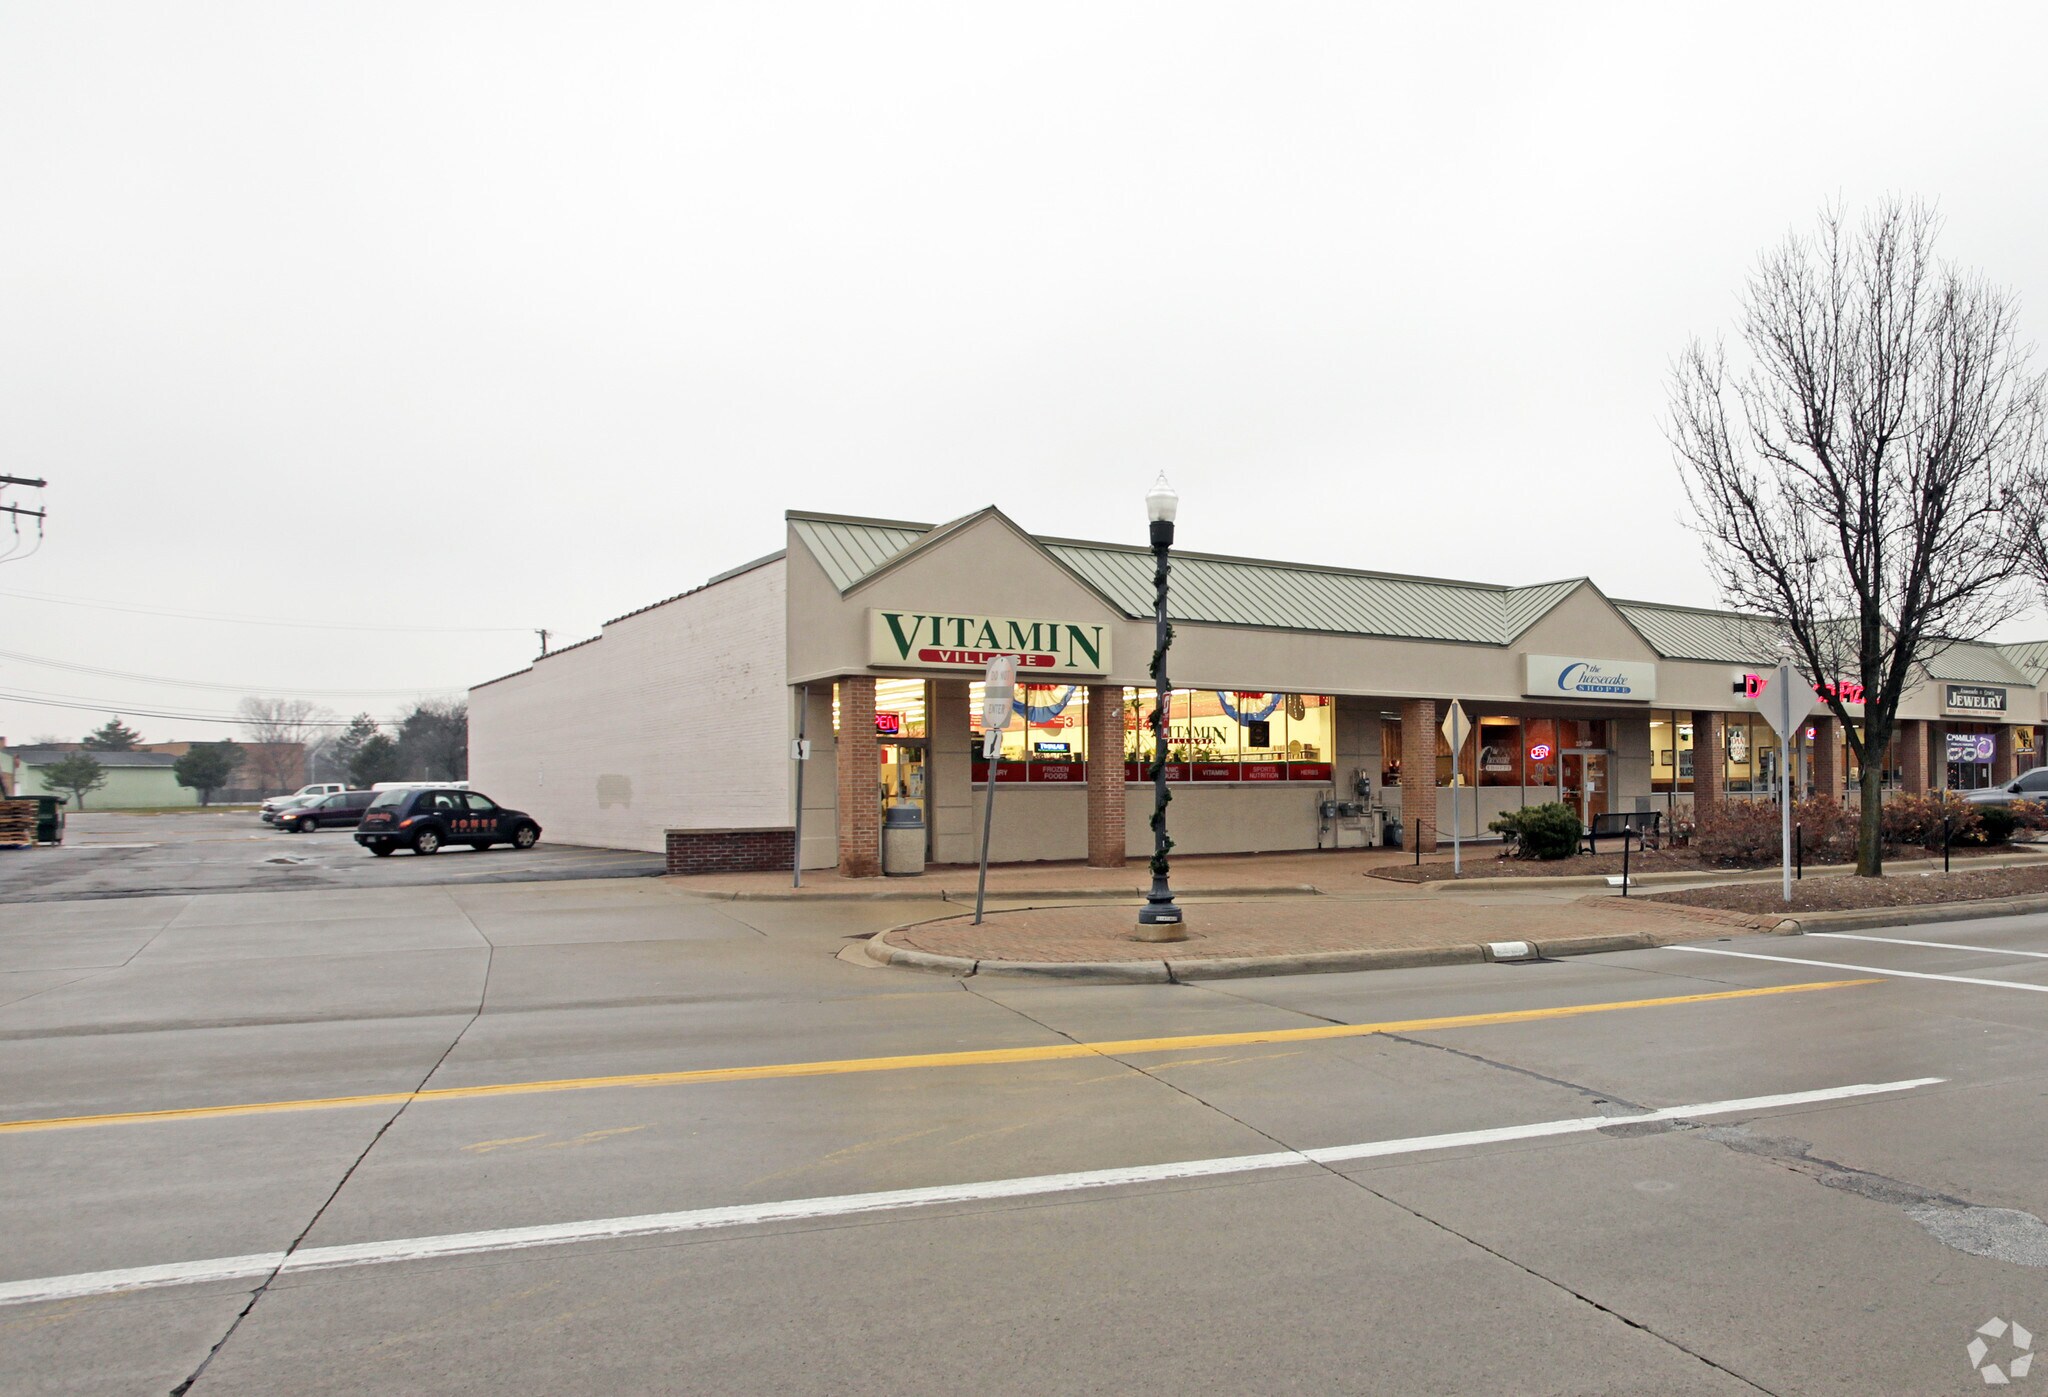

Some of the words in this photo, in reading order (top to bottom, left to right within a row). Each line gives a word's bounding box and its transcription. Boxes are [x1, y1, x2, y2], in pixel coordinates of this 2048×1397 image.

[881, 613, 1103, 669] VITAMIN
[939, 651, 1036, 666] VILLE
[1558, 662, 1628, 690] Cheesecake
[1579, 685, 1629, 693] SHOPPE
[1949, 692, 2003, 709] JEWELRY
[989, 704, 1005, 714] ENTER
[875, 715, 898, 729] PEN
[1066, 717, 1074, 727] 3
[1168, 726, 1228, 744] ITAMIN
[1531, 748, 1549, 757] OPEN
[451, 819, 497, 828] JONES
